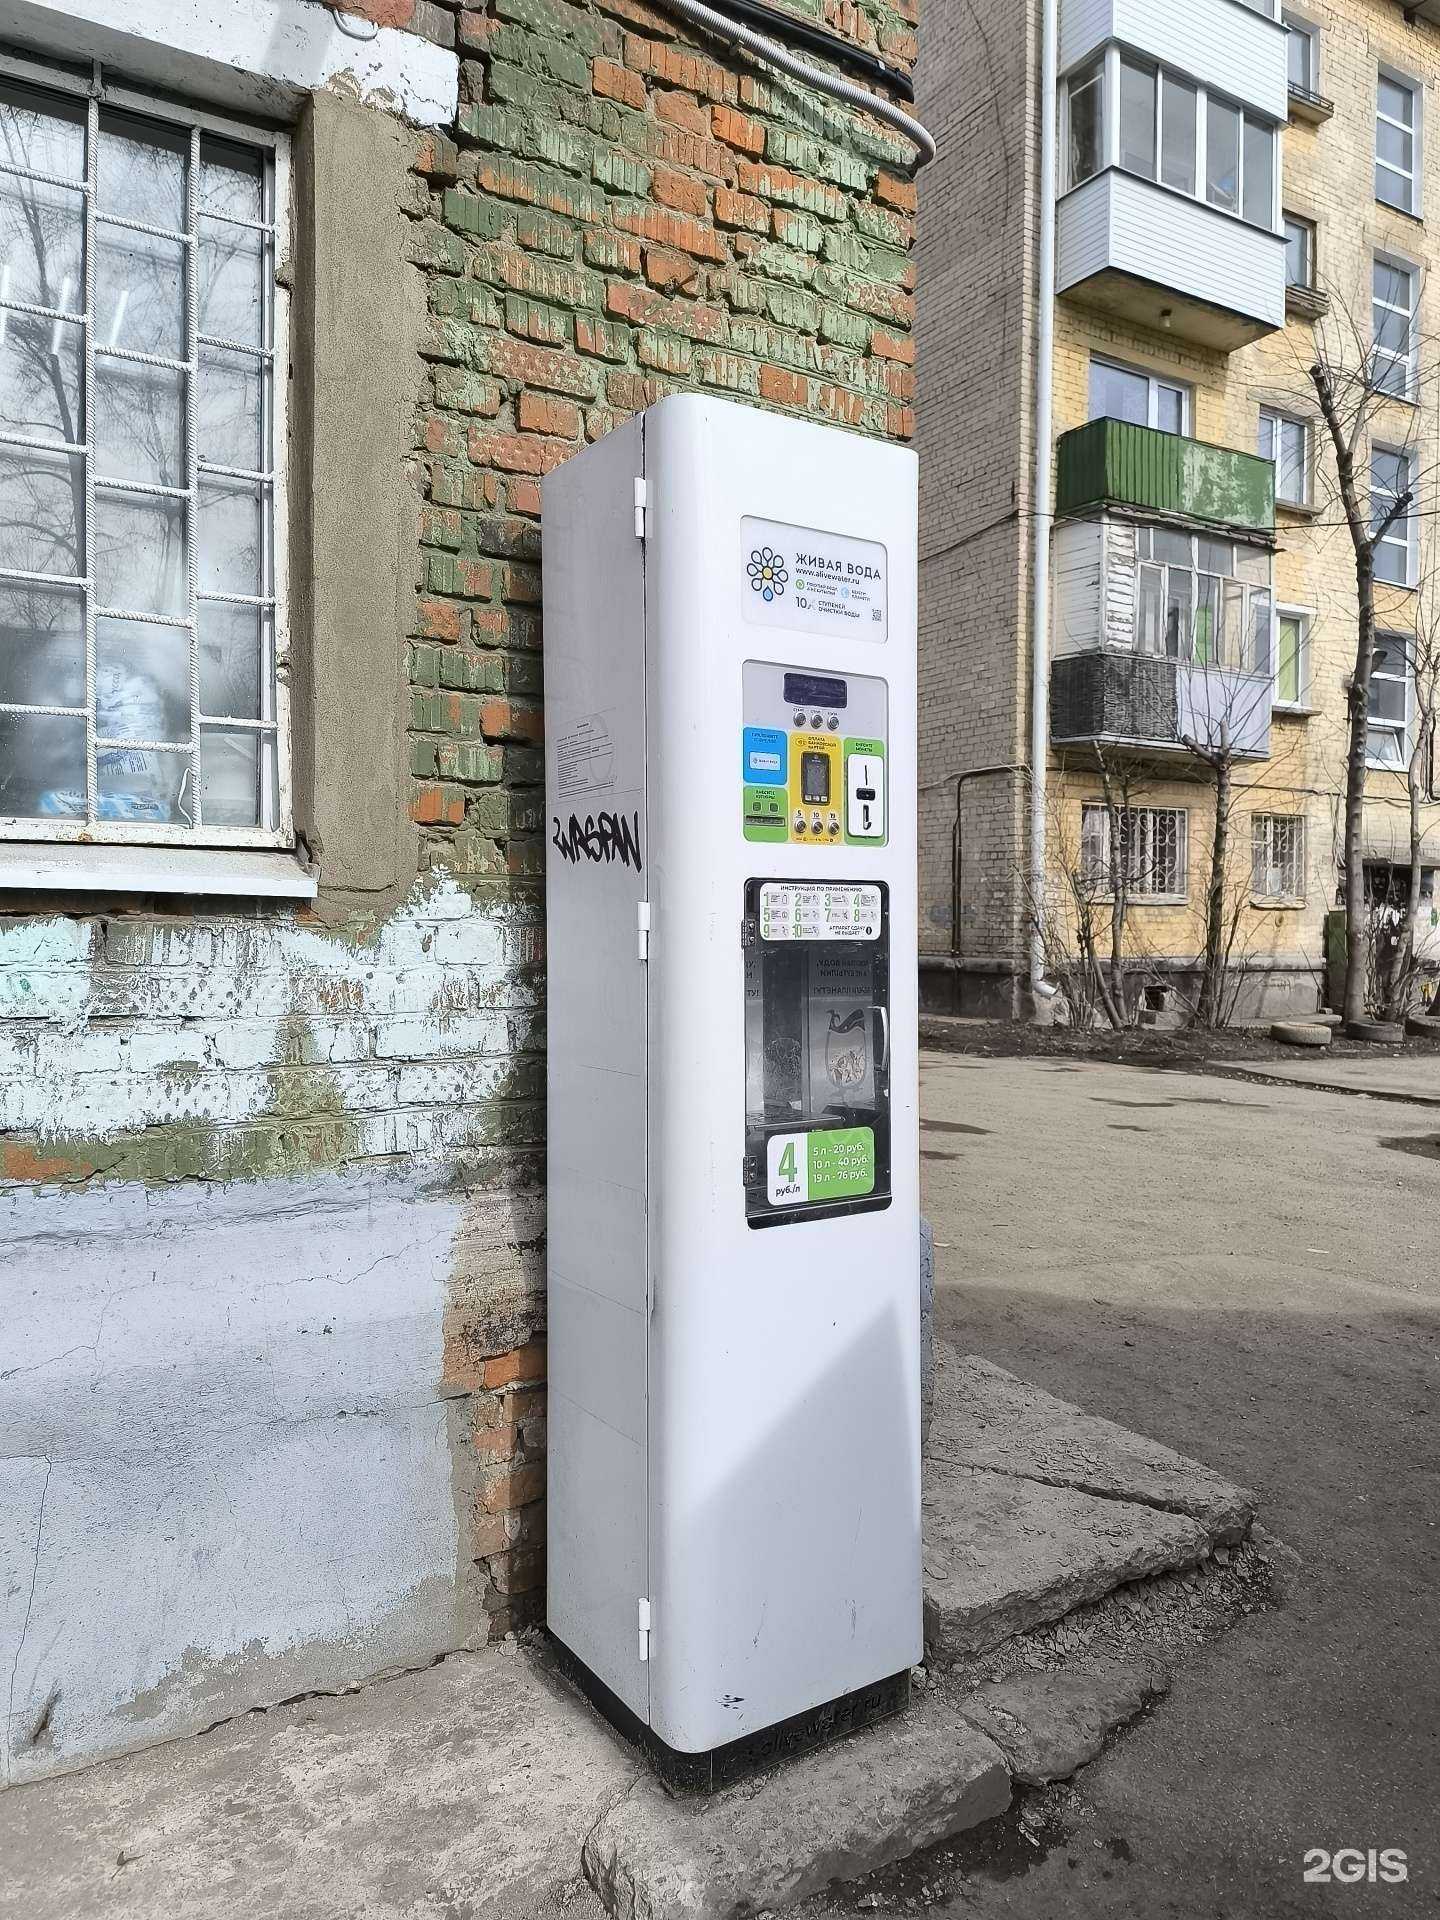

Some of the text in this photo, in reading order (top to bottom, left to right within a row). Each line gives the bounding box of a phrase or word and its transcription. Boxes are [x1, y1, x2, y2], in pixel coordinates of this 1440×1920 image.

[796, 552, 881, 580] ЖИВАЯ ВОДА
[795, 568, 860, 584] www.alivewater.ru
[818, 600, 846, 610] СТУПЕНЕЙ
[818, 607, 843, 615] ОЧИСТКИ
[763, 892, 769, 906] 1
[795, 893, 801, 907] 2
[825, 893, 831, 907] 3
[853, 893, 860, 907] 4
[763, 908, 770, 922] 5
[795, 908, 800, 922] 6
[825, 908, 831, 922] 7
[853, 908, 860, 922] 8
[763, 924, 770, 938] 9
[792, 924, 801, 938] 10
[813, 1147, 819, 1156] 5
[833, 1144, 844, 1154] 20
[847, 1142, 864, 1154] руб.
[779, 1143, 797, 1182] 4
[813, 1160, 823, 1169] 10
[824, 1160, 830, 1168] л
[838, 1157, 849, 1166] 40
[813, 1173, 822, 1183] 19
[837, 1170, 848, 1180] 76
[850, 1168, 868, 1180] руб.
[776, 1184, 800, 1197] руб./л
